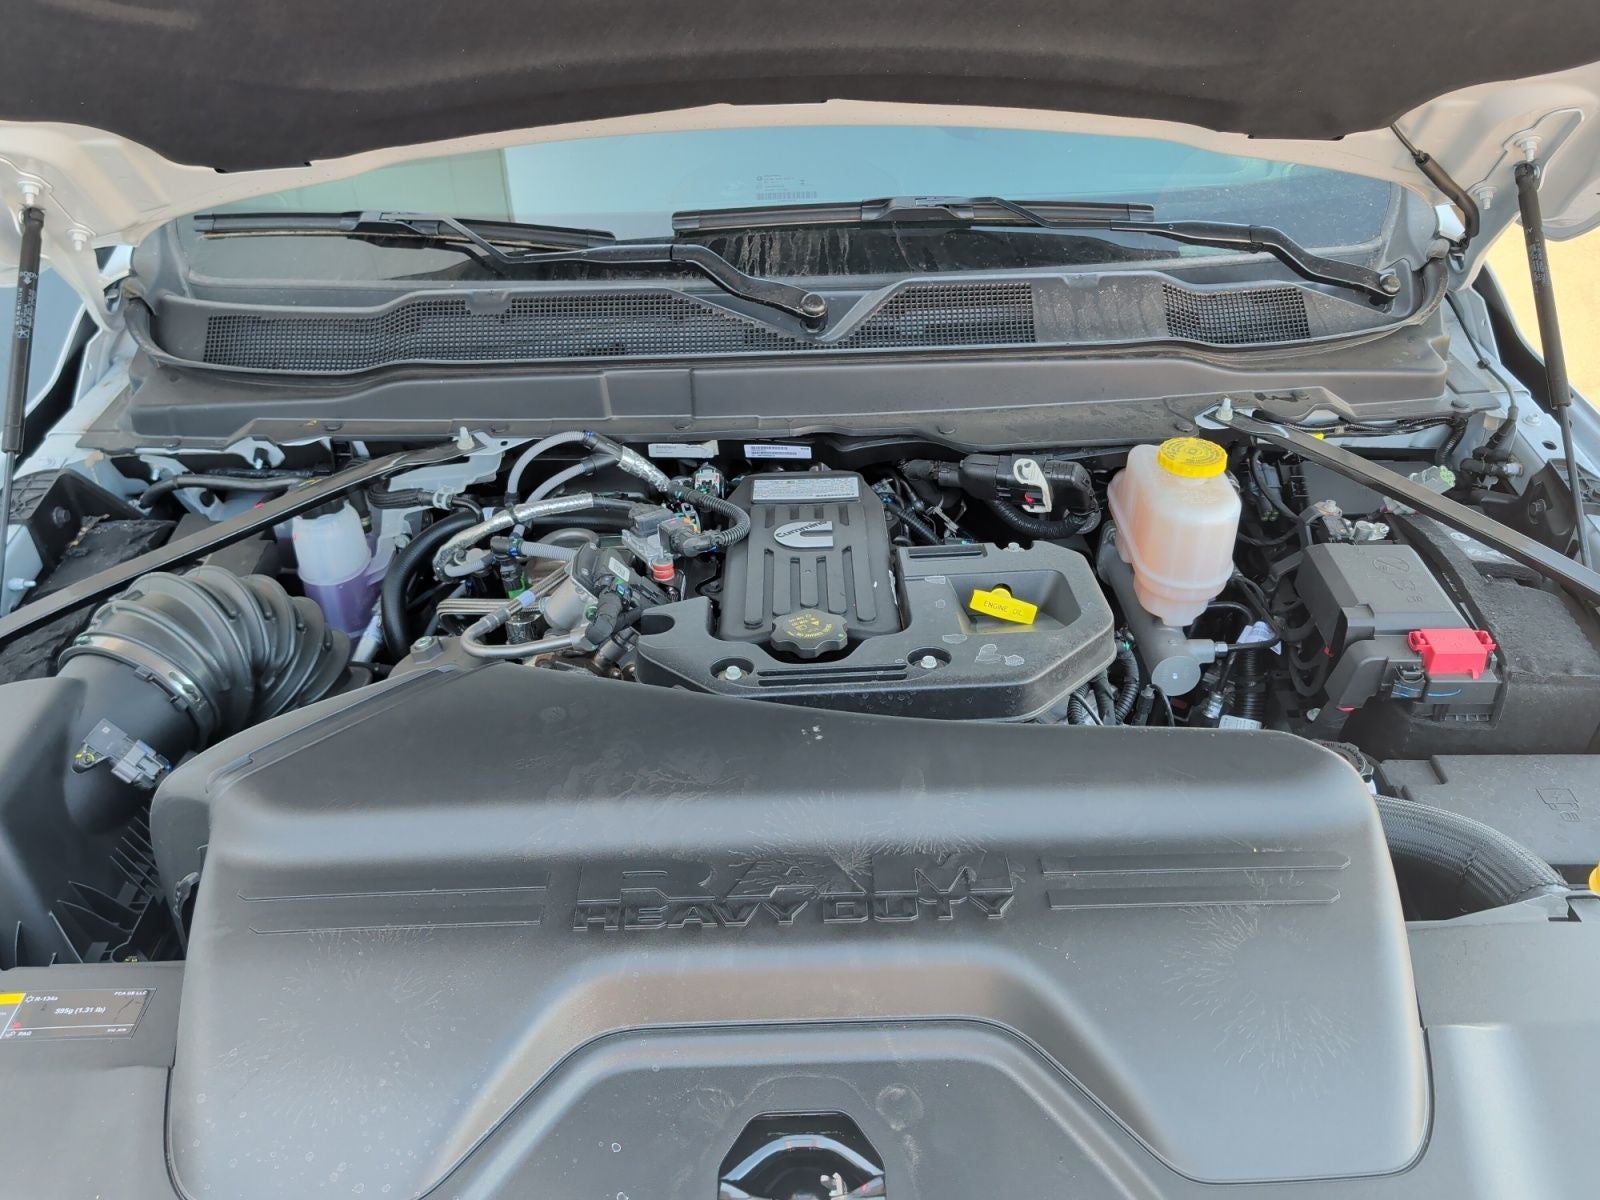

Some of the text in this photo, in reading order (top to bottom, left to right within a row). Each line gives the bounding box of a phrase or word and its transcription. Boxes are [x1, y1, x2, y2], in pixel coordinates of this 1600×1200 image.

[775, 520, 828, 537] Cummins
[983, 600, 1008, 613] ENGINE
[576, 855, 1014, 902] RAM
[572, 896, 1015, 930] HEAVY DUTY
